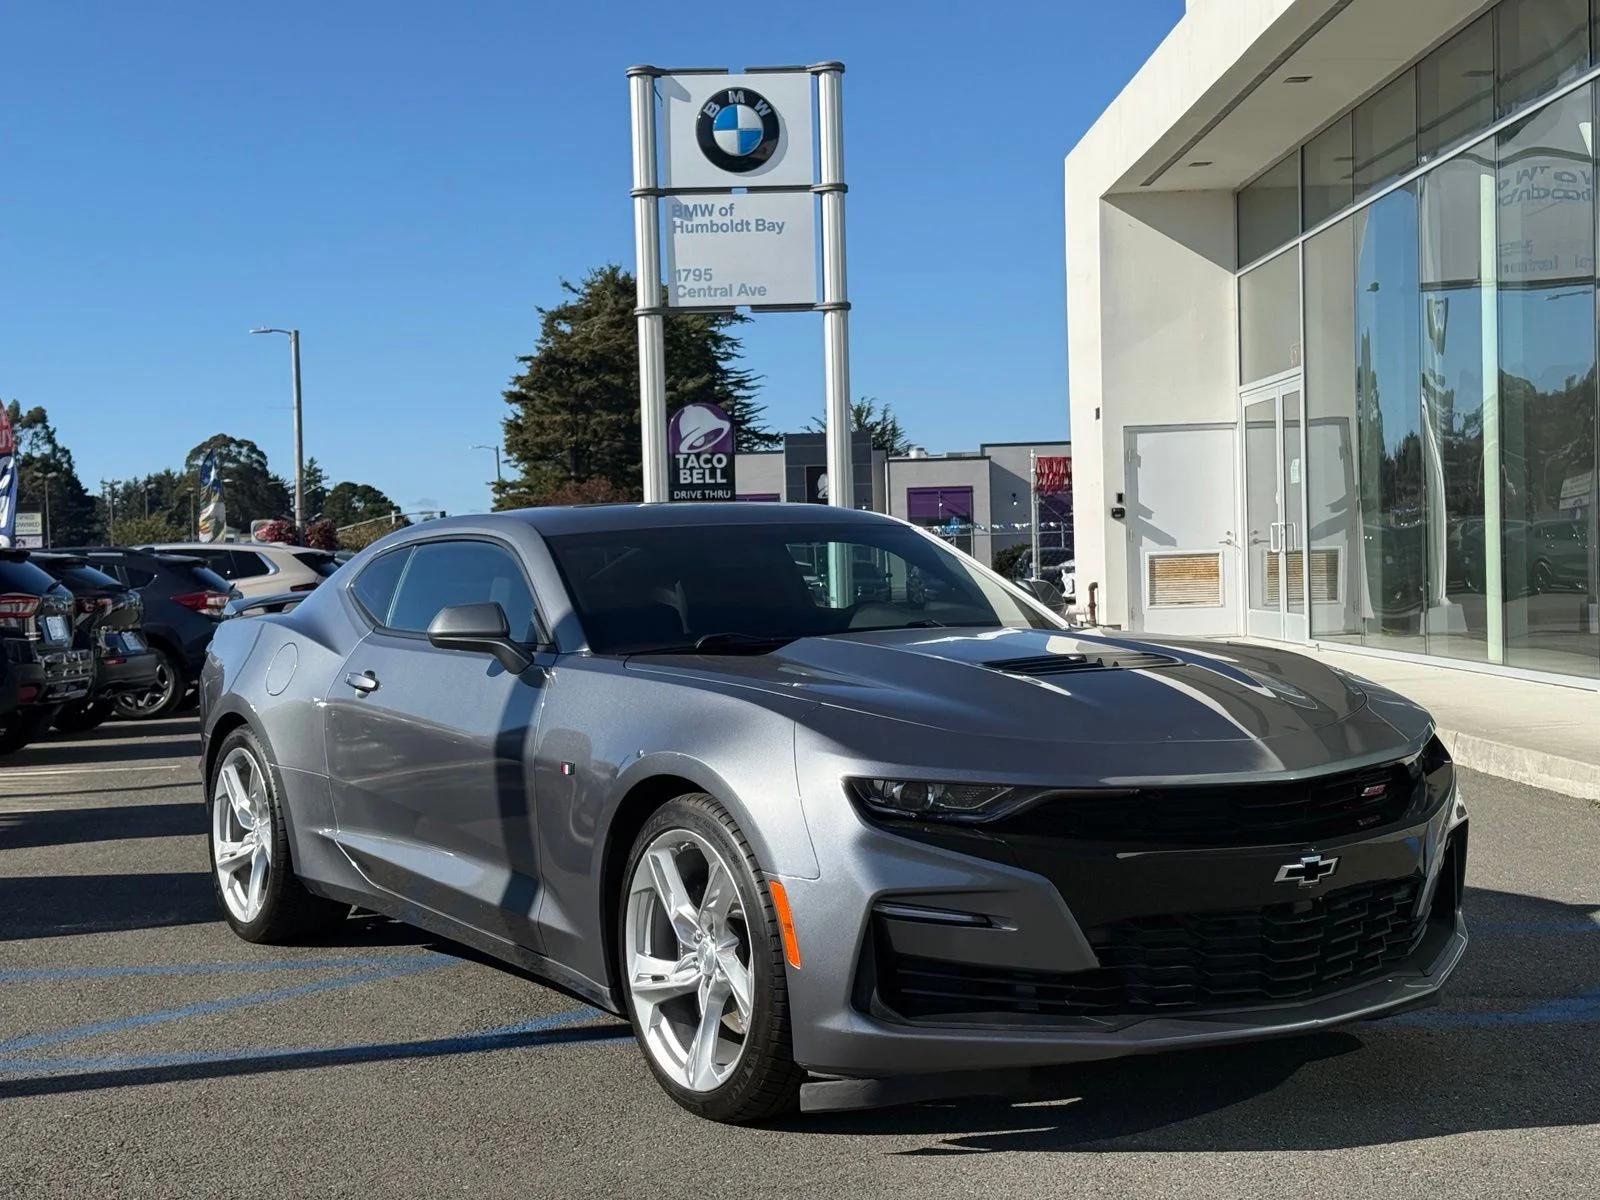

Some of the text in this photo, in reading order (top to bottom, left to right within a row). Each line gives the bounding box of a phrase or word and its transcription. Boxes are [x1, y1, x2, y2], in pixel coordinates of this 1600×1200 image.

[703, 90, 771, 118] BMW
[672, 203, 735, 218] BMW of
[673, 218, 785, 235] Humboldt Bay
[675, 268, 713, 282] 1795
[677, 283, 767, 298] Central Ave
[675, 453, 727, 469] TACO
[679, 469, 728, 484] BELL
[673, 490, 731, 499] DRIVE THRU
